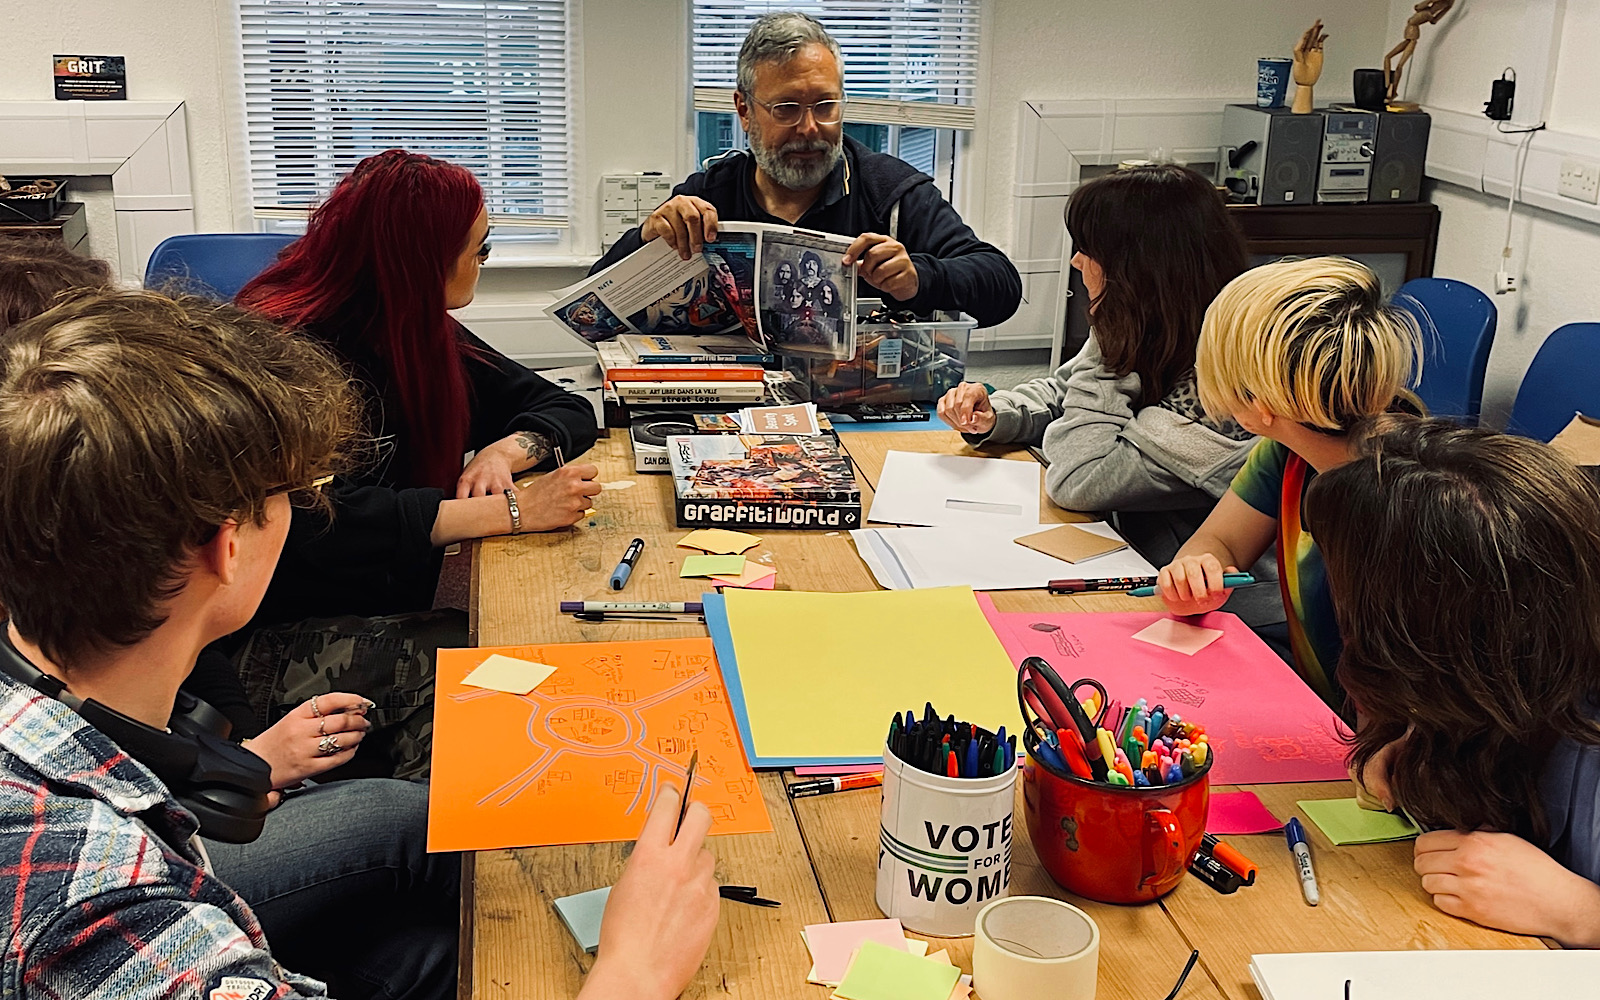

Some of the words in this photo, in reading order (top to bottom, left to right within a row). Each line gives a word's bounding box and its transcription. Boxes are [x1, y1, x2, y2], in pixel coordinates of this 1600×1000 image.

[67, 60, 105, 74] GRIT
[690, 354, 716, 363] graffiti
[695, 395, 720, 404] logos
[644, 456, 657, 465] CAN
[974, 853, 1001, 869] FOR
